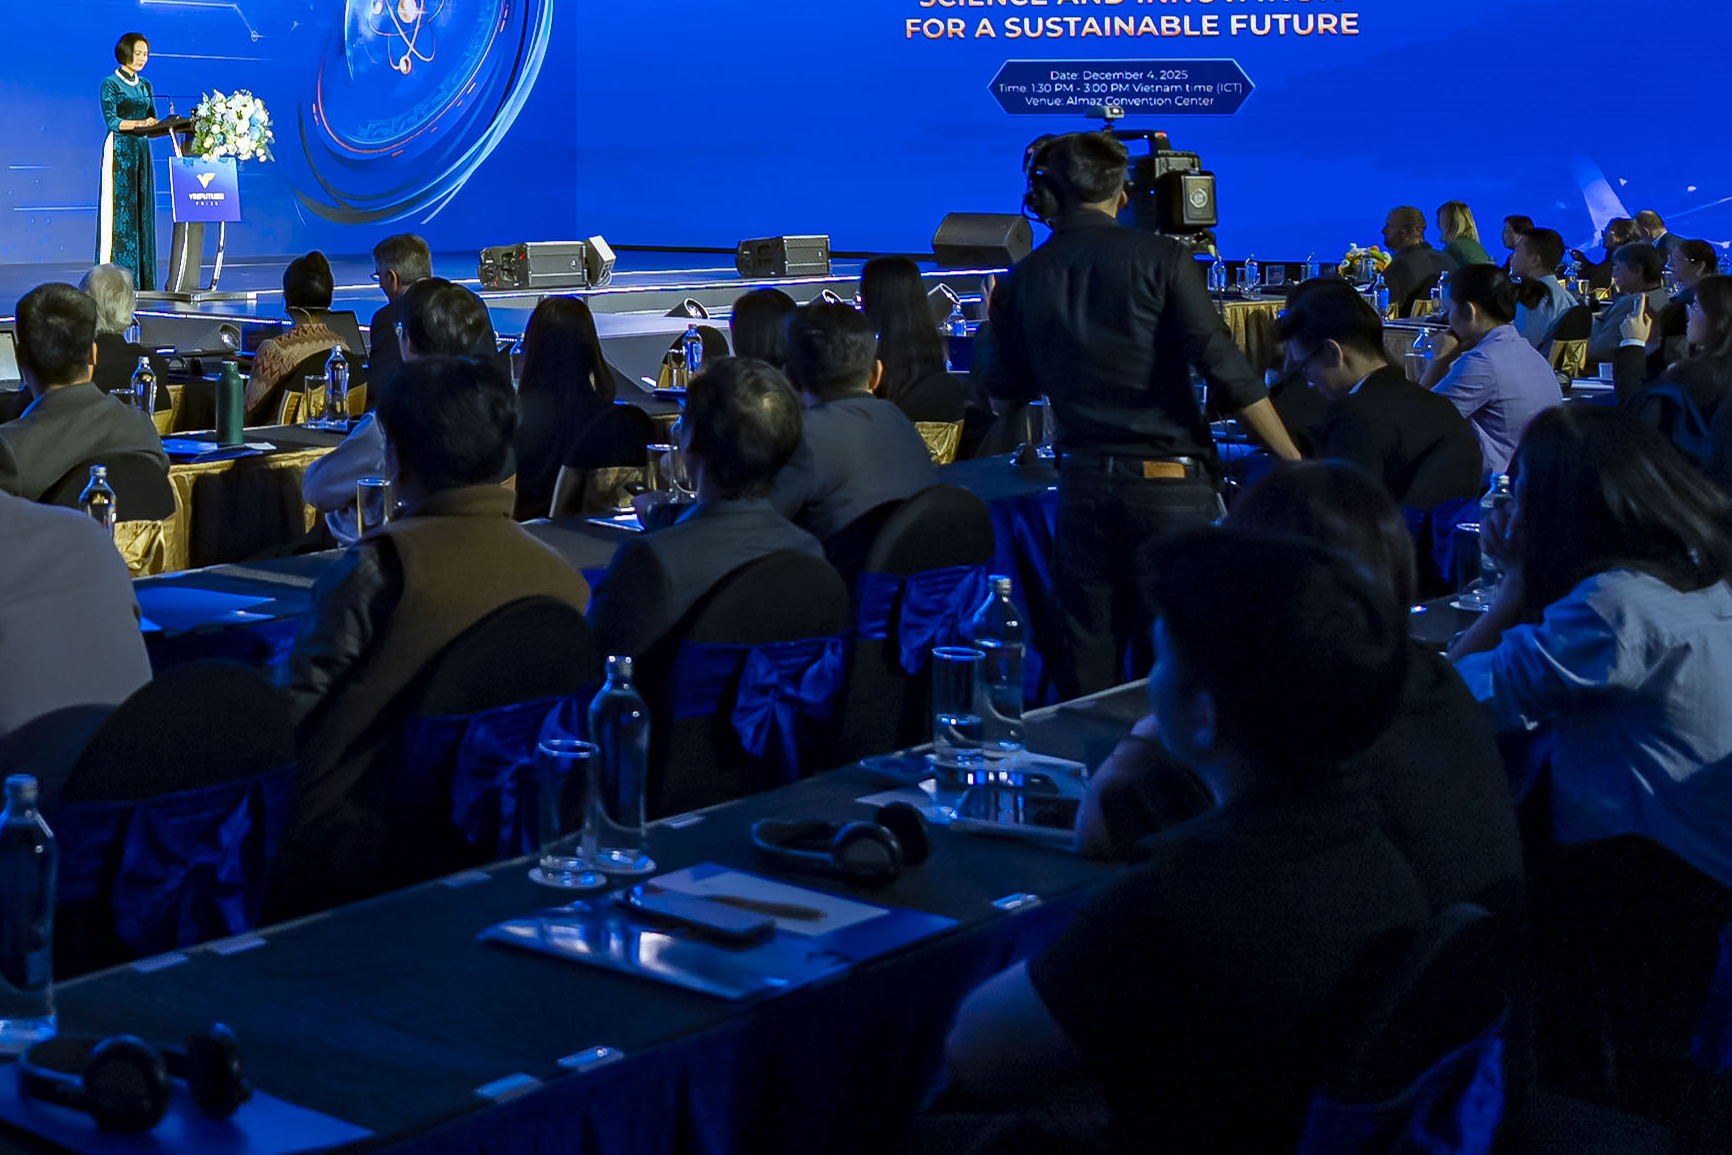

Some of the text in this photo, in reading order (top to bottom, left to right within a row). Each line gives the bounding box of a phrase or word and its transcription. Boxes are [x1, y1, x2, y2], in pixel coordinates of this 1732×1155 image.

[905, 12, 1360, 40] FOR A SUSTAINABLE FUTURE
[1050, 70, 1080, 80] Date:
[1083, 70, 1144, 80] December
[1159, 70, 1189, 80] 2025
[999, 83, 1029, 93] Time:
[1054, 83, 1073, 93] PM
[1083, 82, 1108, 93] 3:00
[1110, 83, 1130, 93] PM
[1132, 83, 1183, 93] Vietnam
[1185, 83, 1214, 93] time
[1216, 82, 1243, 95] (ICT)
[1025, 95, 1214, 106] Venue: Almaz Convention Center
